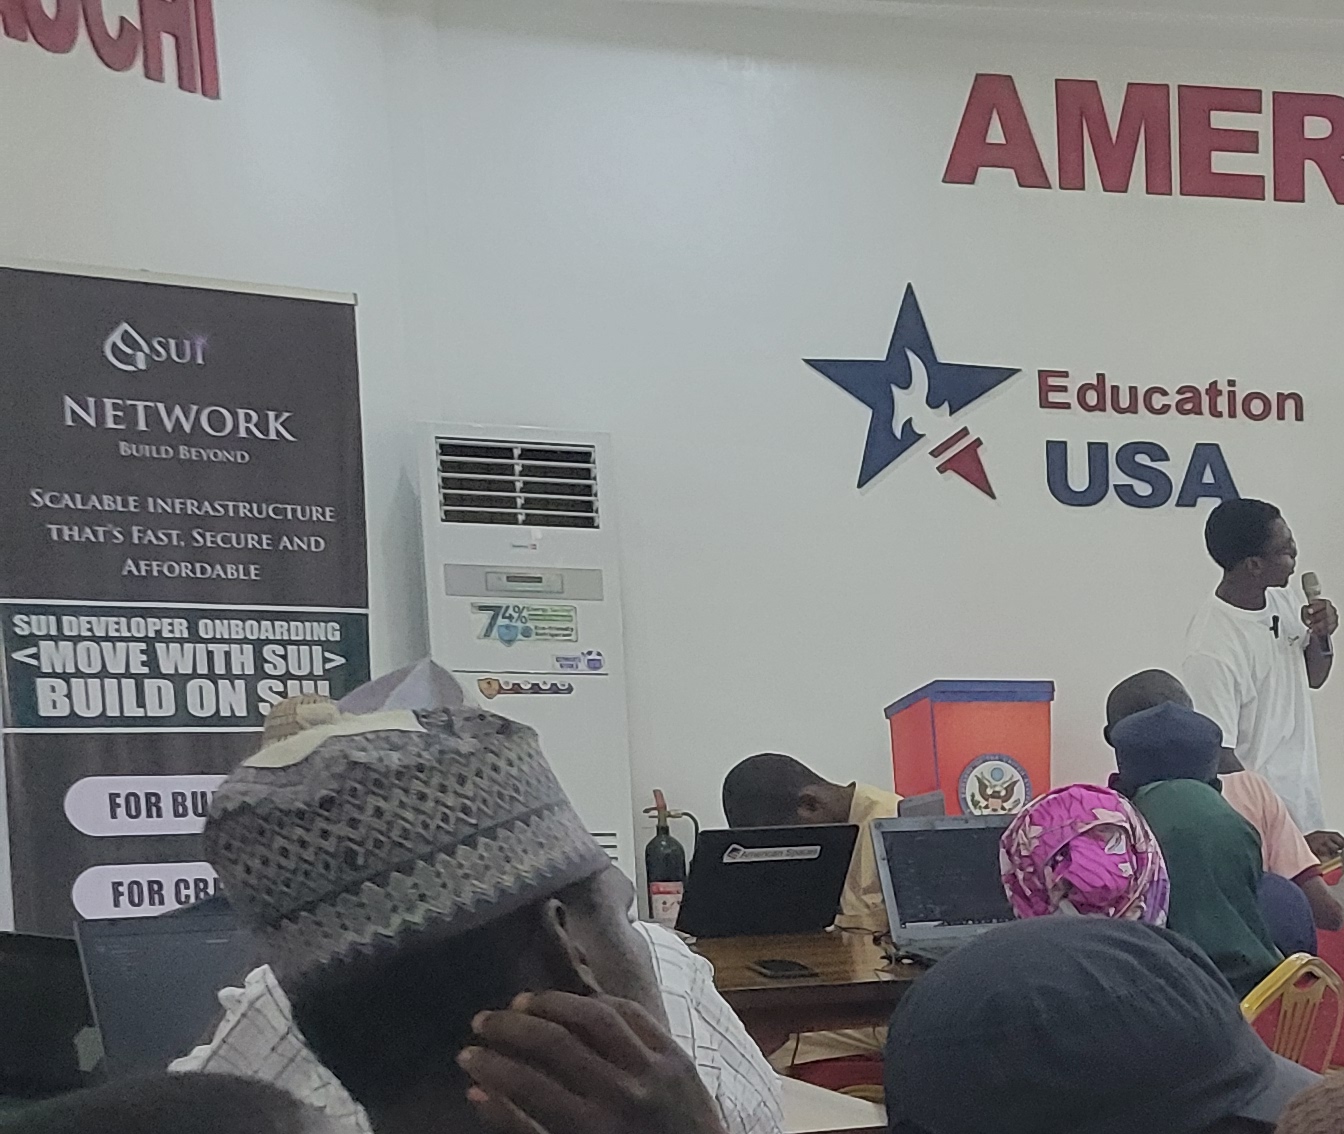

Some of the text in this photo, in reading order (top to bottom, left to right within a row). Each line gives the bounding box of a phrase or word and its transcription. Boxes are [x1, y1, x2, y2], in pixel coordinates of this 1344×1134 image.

[151, 336, 206, 365] SUI
[1037, 369, 1306, 423] Education
[63, 394, 298, 441] NETWORK
[1044, 438, 1242, 509] USA
[30, 488, 337, 522] SCALABLE INFRASTRUCTURE
[46, 524, 124, 544] THAT'S
[192, 528, 272, 550] SECURE
[279, 536, 326, 552] AND
[121, 558, 261, 580] AFFORDABLE
[12, 615, 340, 641] SUI DEVELOPER ONBOARDING
[11, 641, 346, 676] <MOVE WITH SUI>
[35, 677, 176, 718] BUILD
[186, 678, 247, 718] ON
[108, 791, 163, 820] FOR
[111, 879, 165, 908] FOR
